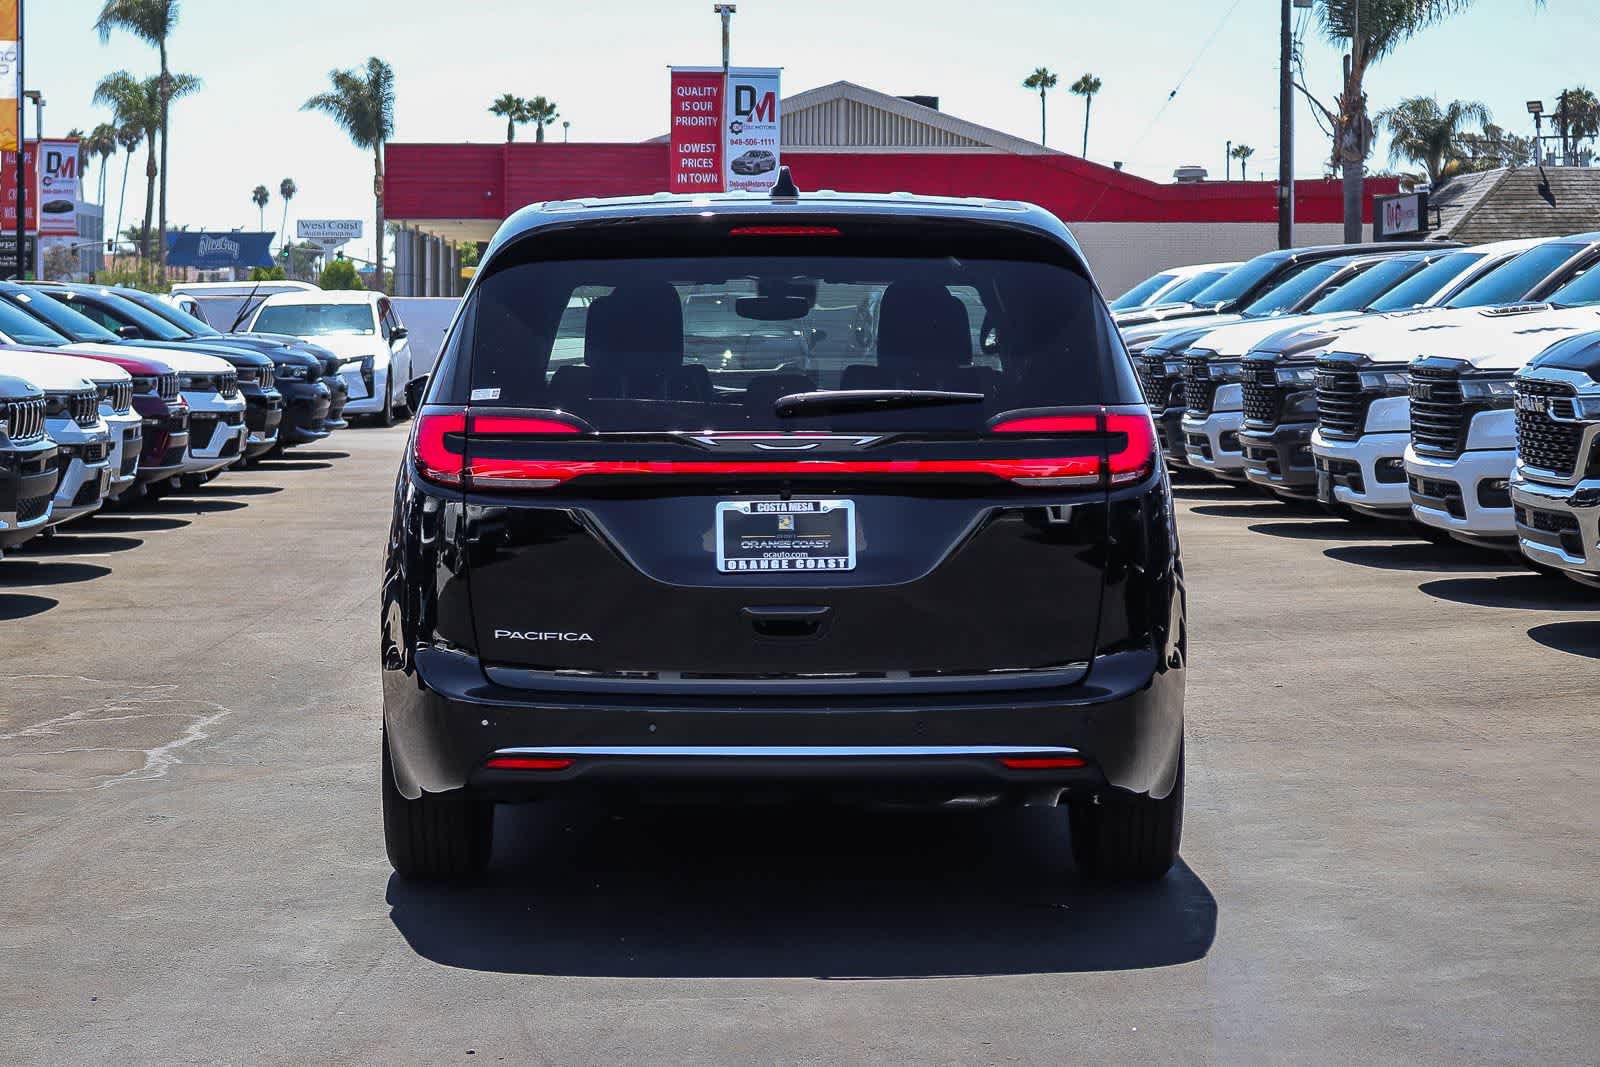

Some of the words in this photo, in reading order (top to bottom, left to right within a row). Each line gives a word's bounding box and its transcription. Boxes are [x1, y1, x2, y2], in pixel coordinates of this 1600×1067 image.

[677, 86, 718, 97] QUALITY
[682, 101, 692, 111] IS
[693, 101, 713, 111] OUR
[735, 85, 776, 123] DM
[675, 116, 717, 127] PRIORITY
[679, 143, 717, 153] LOWEST
[46, 151, 76, 179] DM
[681, 158, 713, 168] PRICES
[677, 173, 688, 183] IN
[689, 173, 718, 183] TOWN
[301, 221, 326, 230] West
[328, 221, 358, 230] Coast
[757, 502, 787, 512] COSTA
[788, 502, 814, 512] MESA
[741, 540, 791, 549] ORANGE
[792, 539, 831, 549] COAST
[727, 559, 789, 570] ORANGE
[795, 558, 847, 569] COAST
[493, 629, 594, 642] PACIFICA
